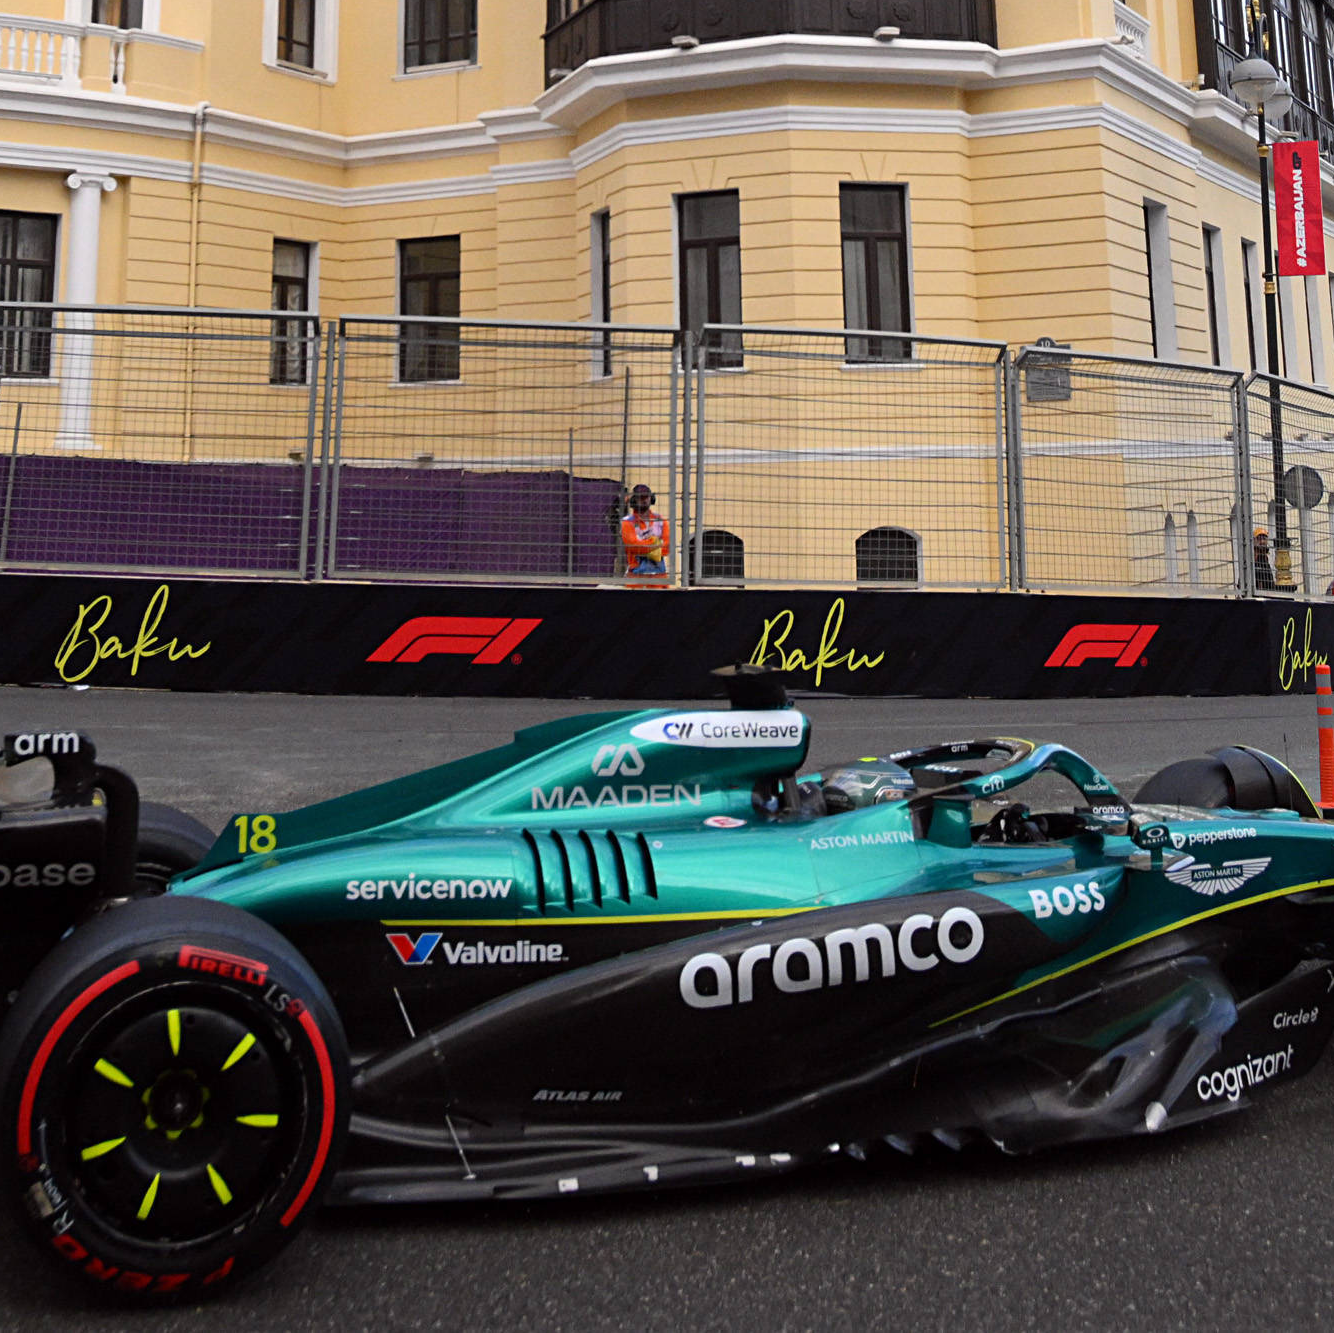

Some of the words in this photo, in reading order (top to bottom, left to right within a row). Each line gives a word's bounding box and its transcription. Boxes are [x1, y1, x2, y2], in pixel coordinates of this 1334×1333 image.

[54, 583, 211, 683] Baku
[365, 616, 543, 664] F1
[750, 598, 885, 687] Baku
[1043, 623, 1160, 668] F1
[1279, 607, 1328, 691] Baku
[14, 731, 80, 755] arm
[700, 721, 800, 739] CoreWeave
[951, 744, 969, 753] arm
[531, 784, 702, 810] MAADEN
[981, 775, 1005, 795] citi
[1092, 805, 1125, 815] aramco
[234, 814, 278, 854] 18
[810, 835, 857, 850] ASTON
[861, 830, 915, 845] MARTIN
[1188, 826, 1258, 847] pepperstone
[346, 871, 513, 900] servicenow
[1193, 870, 1215, 880] ASTON
[1215, 867, 1242, 878] MARTIN
[1028, 881, 1106, 919] BOSS
[178, 944, 269, 987] PIRELLI
[442, 940, 564, 965] Valvoline
[679, 906, 985, 1009] aramco
[1196, 1043, 1295, 1104] cognizant
